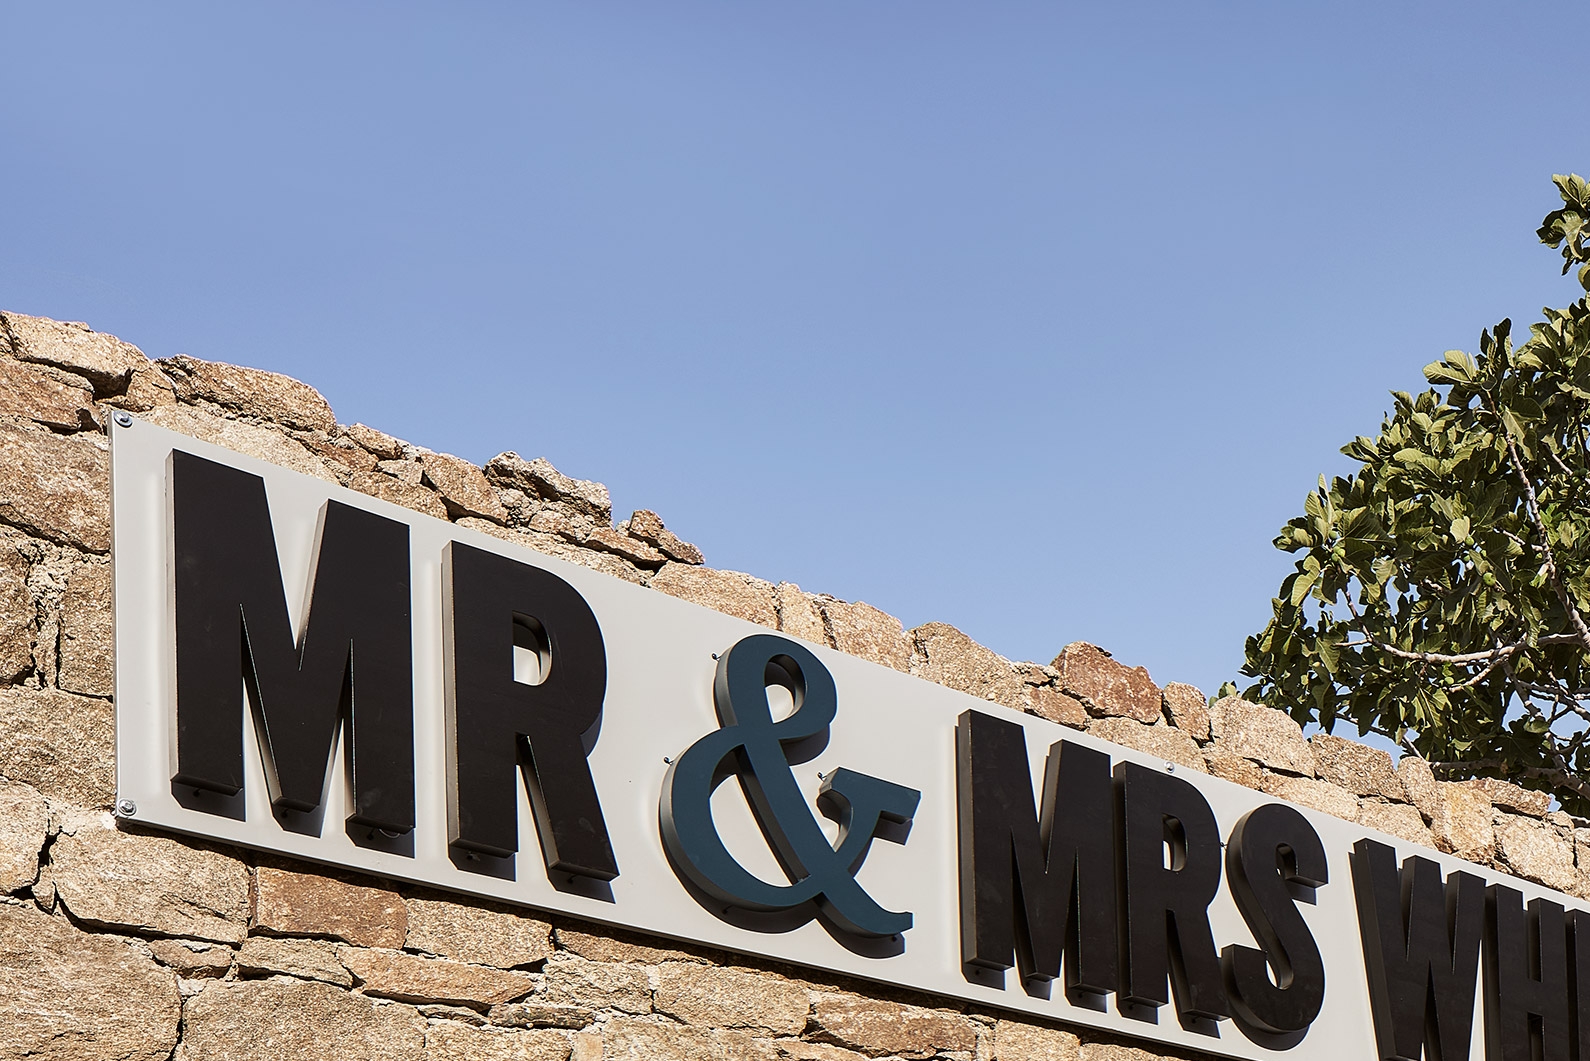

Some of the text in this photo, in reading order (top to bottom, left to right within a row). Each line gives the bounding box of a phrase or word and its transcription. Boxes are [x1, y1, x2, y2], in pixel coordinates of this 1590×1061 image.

[166, 448, 619, 882] MR
[659, 633, 921, 936] &
[956, 709, 1328, 1033] MRS
